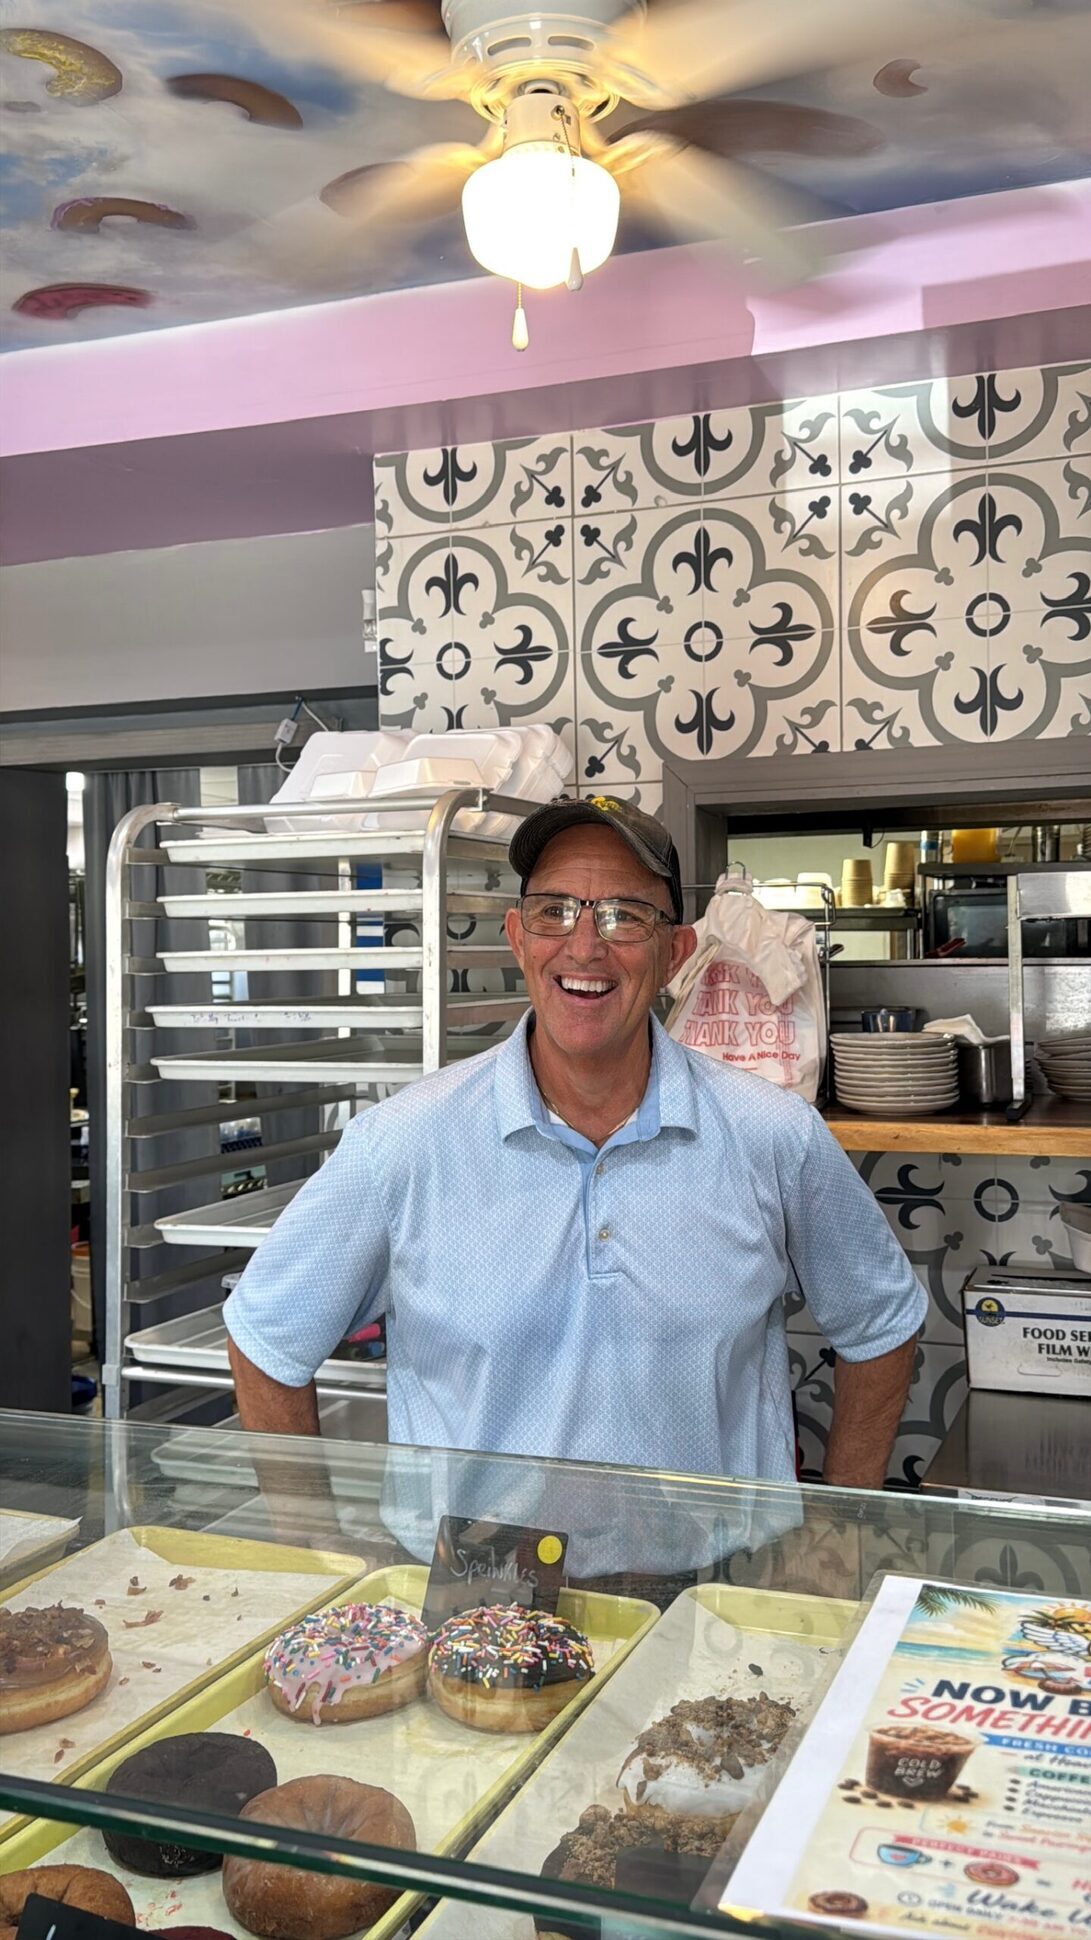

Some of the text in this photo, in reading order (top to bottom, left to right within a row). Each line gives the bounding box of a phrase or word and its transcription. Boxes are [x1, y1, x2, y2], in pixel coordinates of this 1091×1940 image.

[745, 1021, 796, 1046] YOU
[722, 1050, 801, 1062] Have A Nice Day
[1022, 1327, 1066, 1341] FOOD
[1037, 1343, 1072, 1356] FILM
[931, 1679, 1055, 1712] NOW
[1001, 1737, 1091, 1757] FRESH CO
[897, 1757, 942, 1770] COLD
[894, 1767, 942, 1779] BREW
[967, 1889, 1057, 1918] Wake
